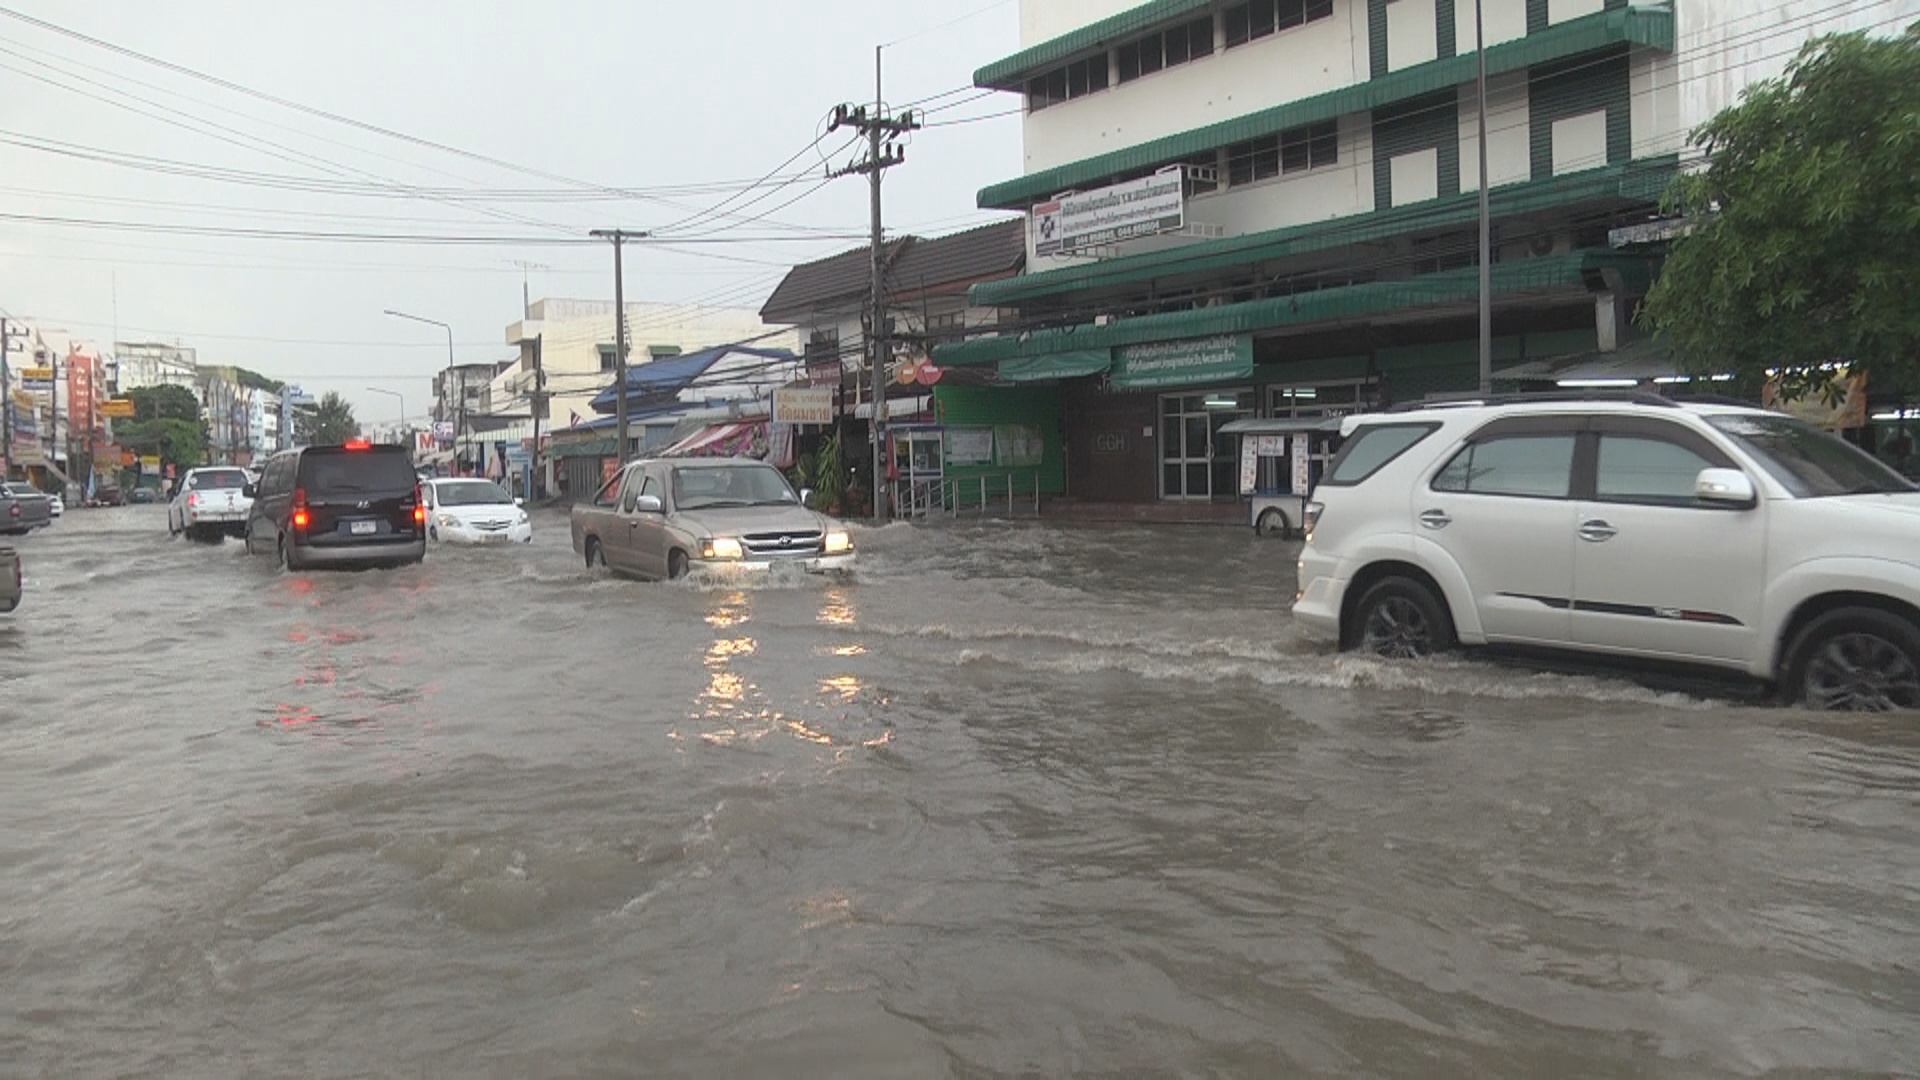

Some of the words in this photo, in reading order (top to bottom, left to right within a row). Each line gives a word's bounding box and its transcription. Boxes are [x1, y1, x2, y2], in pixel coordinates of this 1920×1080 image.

[777, 403, 830, 420] ตัดผมชาย
[420, 433, 435, 448] M
